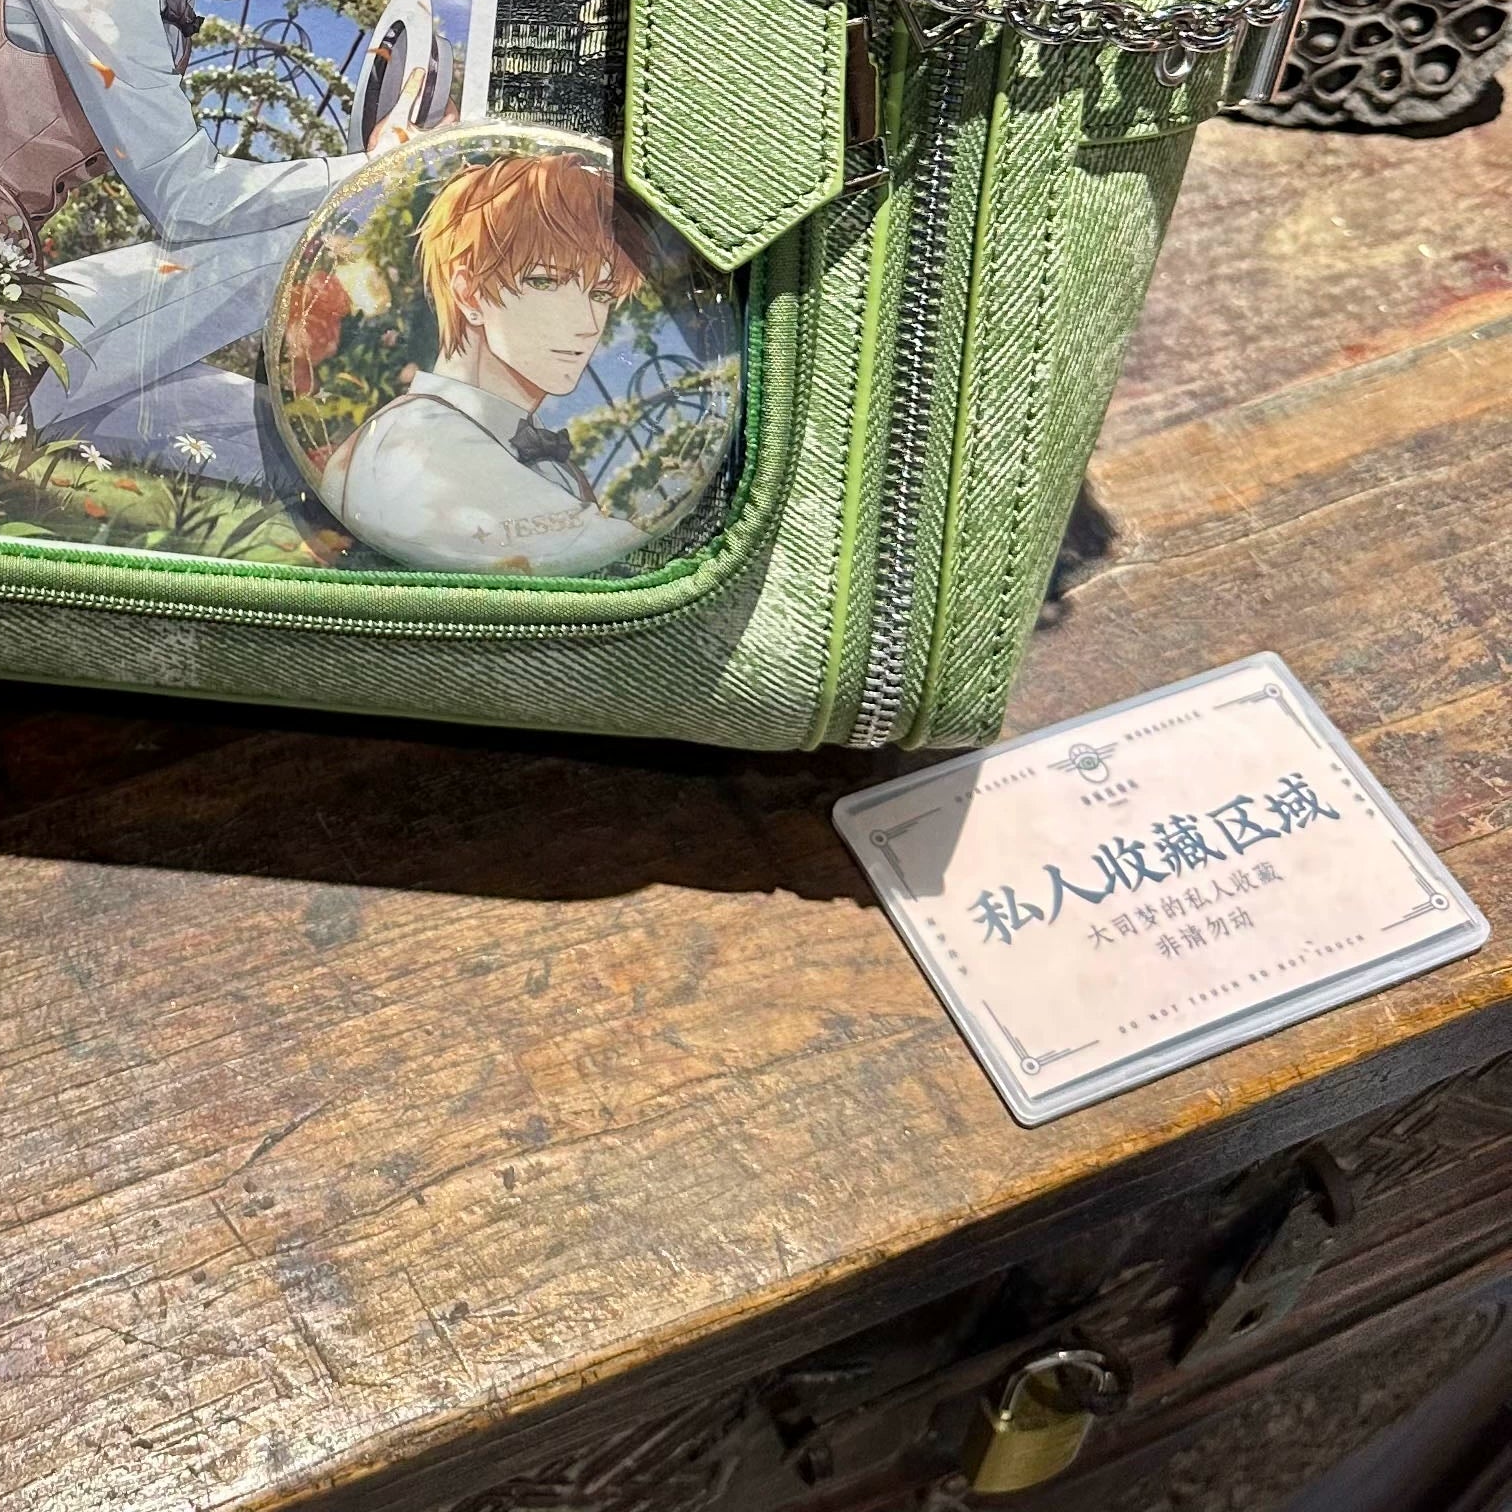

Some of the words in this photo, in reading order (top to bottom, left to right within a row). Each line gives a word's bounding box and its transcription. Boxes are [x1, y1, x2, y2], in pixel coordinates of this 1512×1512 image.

[968, 772, 1340, 946] 私人收藏区域
[1088, 861, 1284, 949] 大司梦的私人收藏
[1157, 906, 1255, 958] 非请勿动
